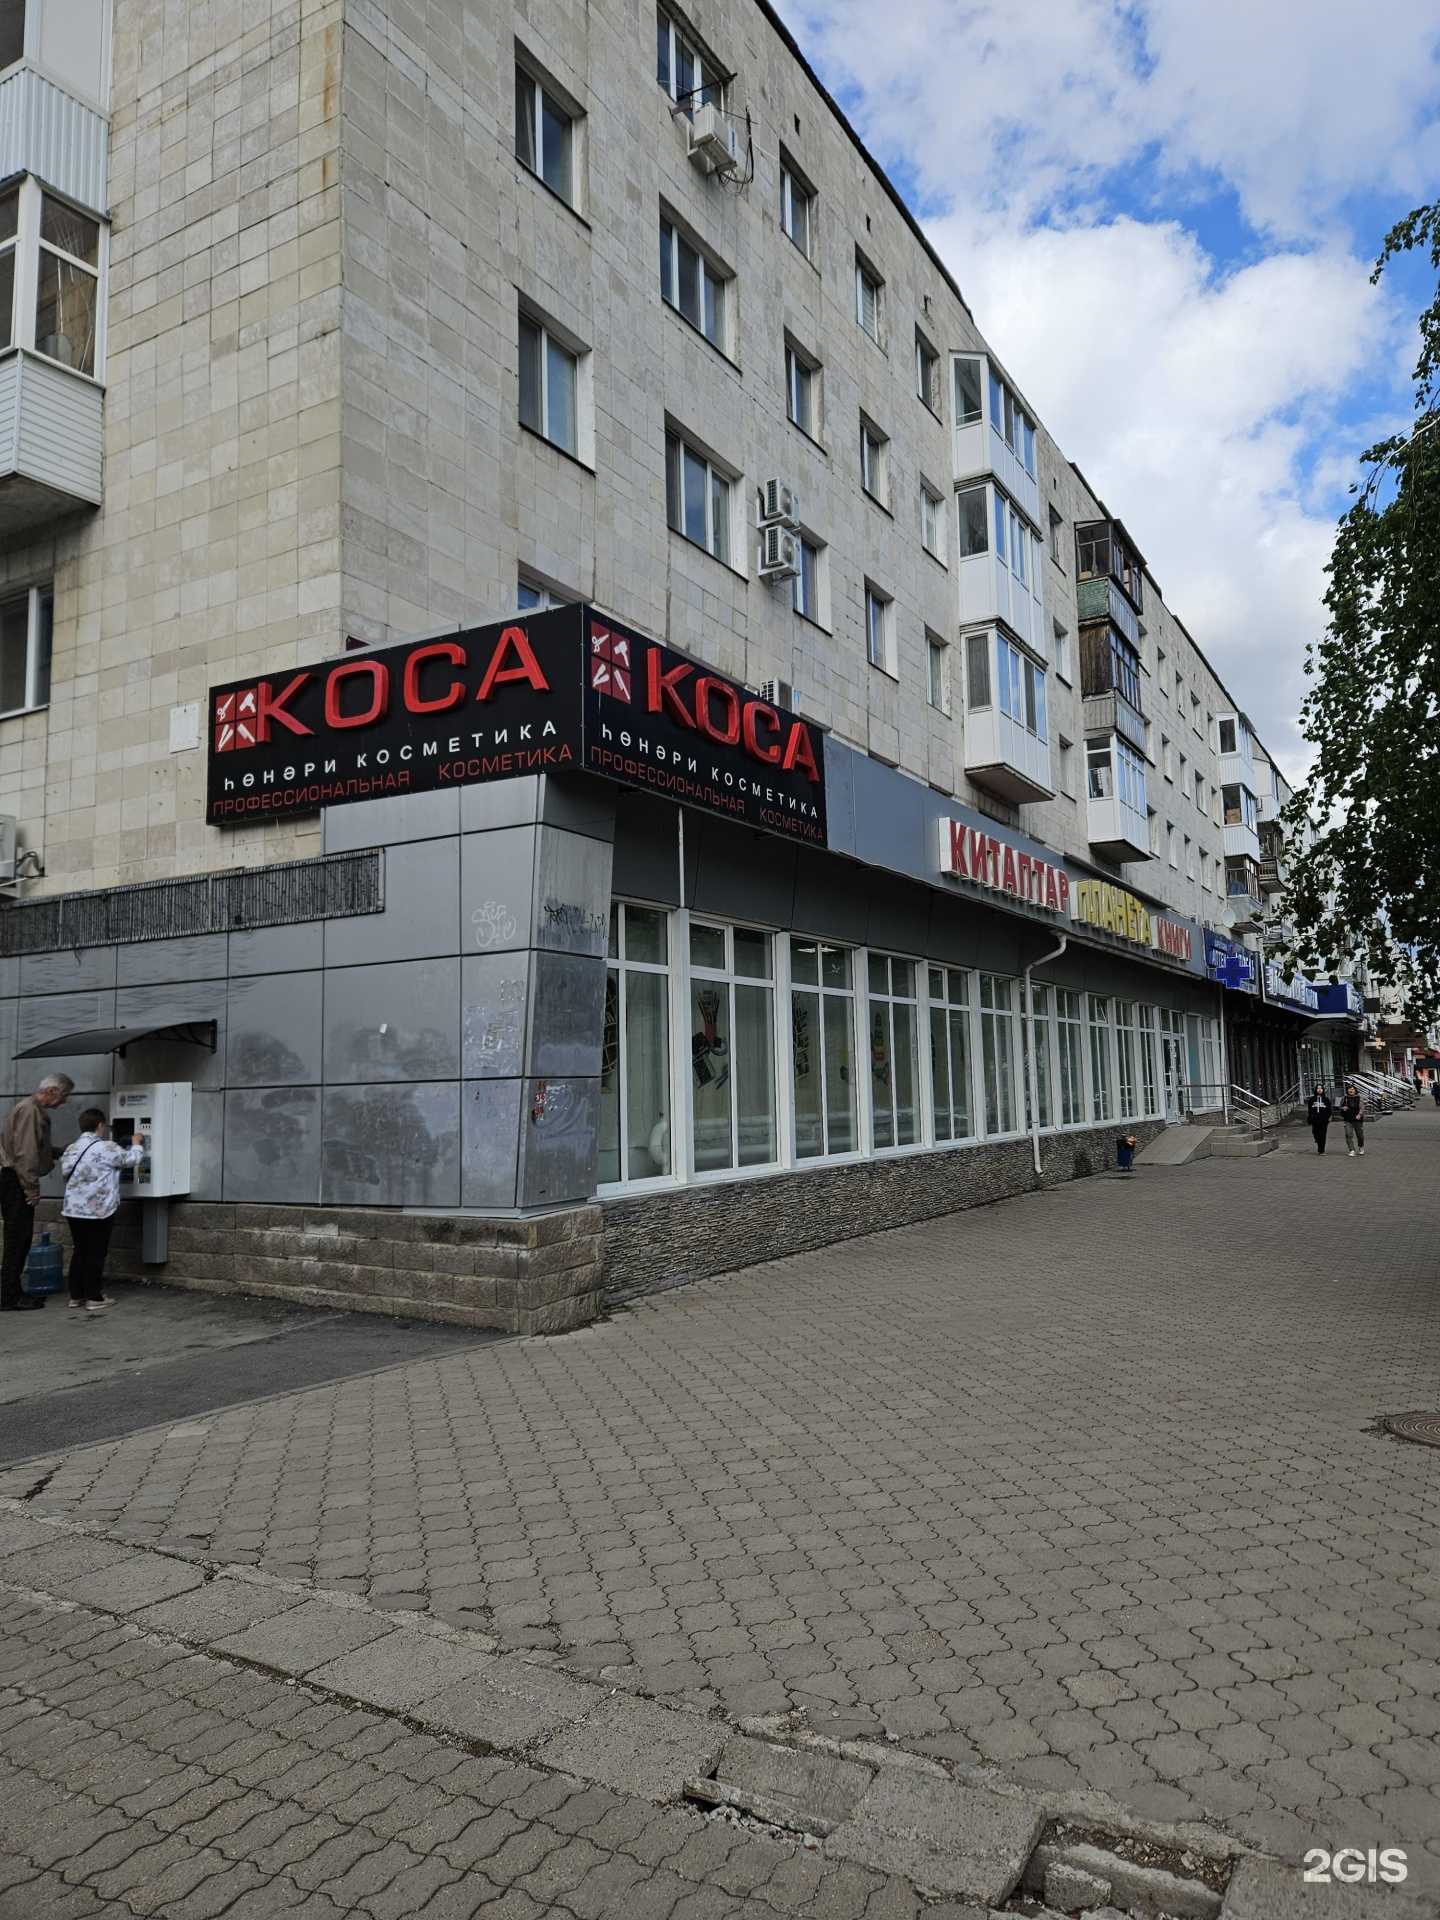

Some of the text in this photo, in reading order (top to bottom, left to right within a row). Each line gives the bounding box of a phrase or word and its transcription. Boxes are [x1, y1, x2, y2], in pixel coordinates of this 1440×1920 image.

[256, 626, 550, 743] КОСА
[647, 646, 821, 783] КОСА
[212, 743, 573, 817] ПРОФЕССИОНАЛЬНАЯ КОСМЕТИКА
[356, 719, 557, 769] КОСМЕТИКА
[711, 766, 818, 818] КОСМЕТИКА
[591, 745, 823, 841] ПРОФЕССИОНАЛЬНАЯ КОСМЕТИКА
[942, 817, 1070, 912] КИТАПТАР
[1073, 879, 1152, 946] ПЛАНЕТА
